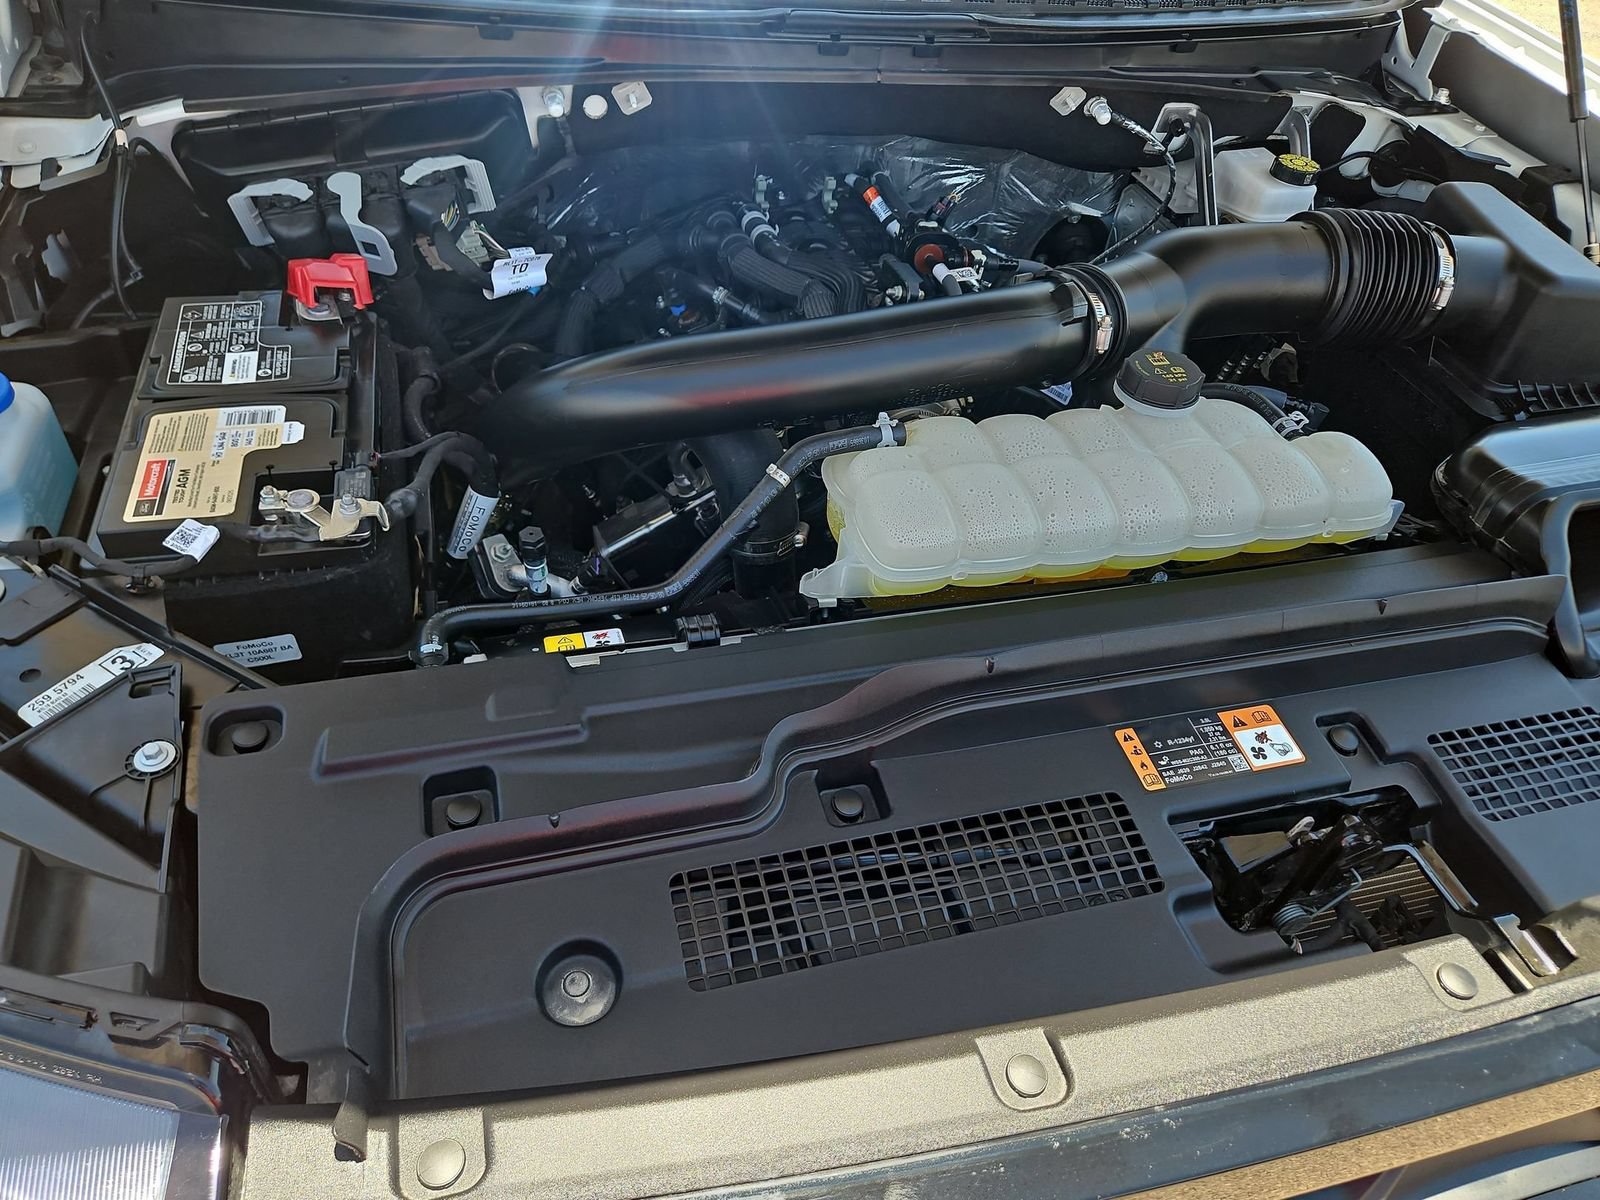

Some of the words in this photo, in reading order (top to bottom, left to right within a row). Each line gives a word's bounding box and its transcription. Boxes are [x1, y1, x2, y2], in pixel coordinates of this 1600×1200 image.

[143, 462, 162, 496] Motorcraft
[176, 468, 191, 489] AGM
[458, 506, 486, 552] FoMoCo
[235, 641, 274, 651] FoMoCo
[111, 655, 136, 671] 3
[27, 695, 53, 712] 259
[52, 673, 85, 695] 5794
[1166, 736, 1195, 746] R-1234yf
[1189, 748, 1204, 756] PAG
[1165, 774, 1193, 784] FoMoCo
